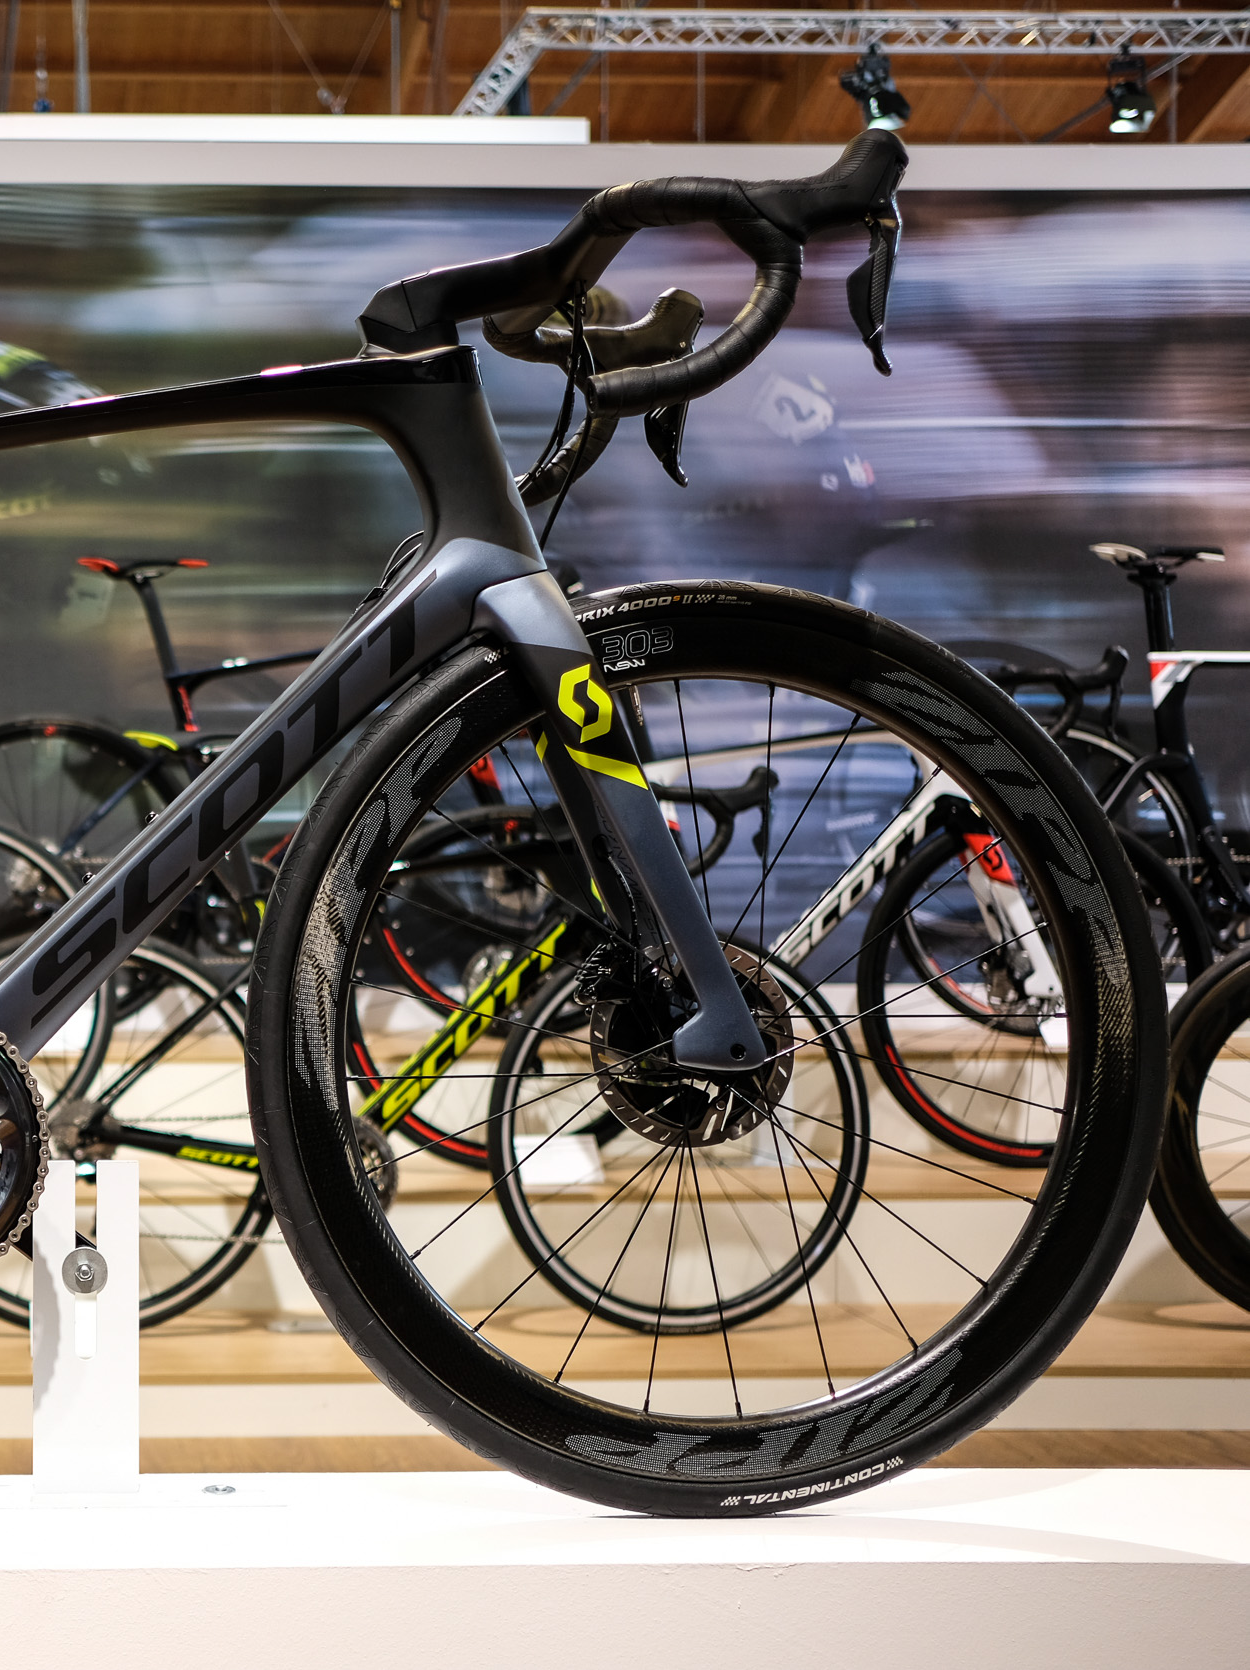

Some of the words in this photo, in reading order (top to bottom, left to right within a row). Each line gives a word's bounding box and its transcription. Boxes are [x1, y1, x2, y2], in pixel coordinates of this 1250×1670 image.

[574, 604, 615, 623] PRIX
[601, 625, 675, 664] 303
[30, 568, 438, 1030] SCOTT
[849, 670, 1128, 989] ZIPP
[294, 715, 463, 1112] ZIPP
[778, 800, 937, 968] SCOTT
[381, 921, 567, 1133] SCOTT
[564, 1346, 964, 1476] ZIPP
[743, 1462, 886, 1505] CONTINENTAL
